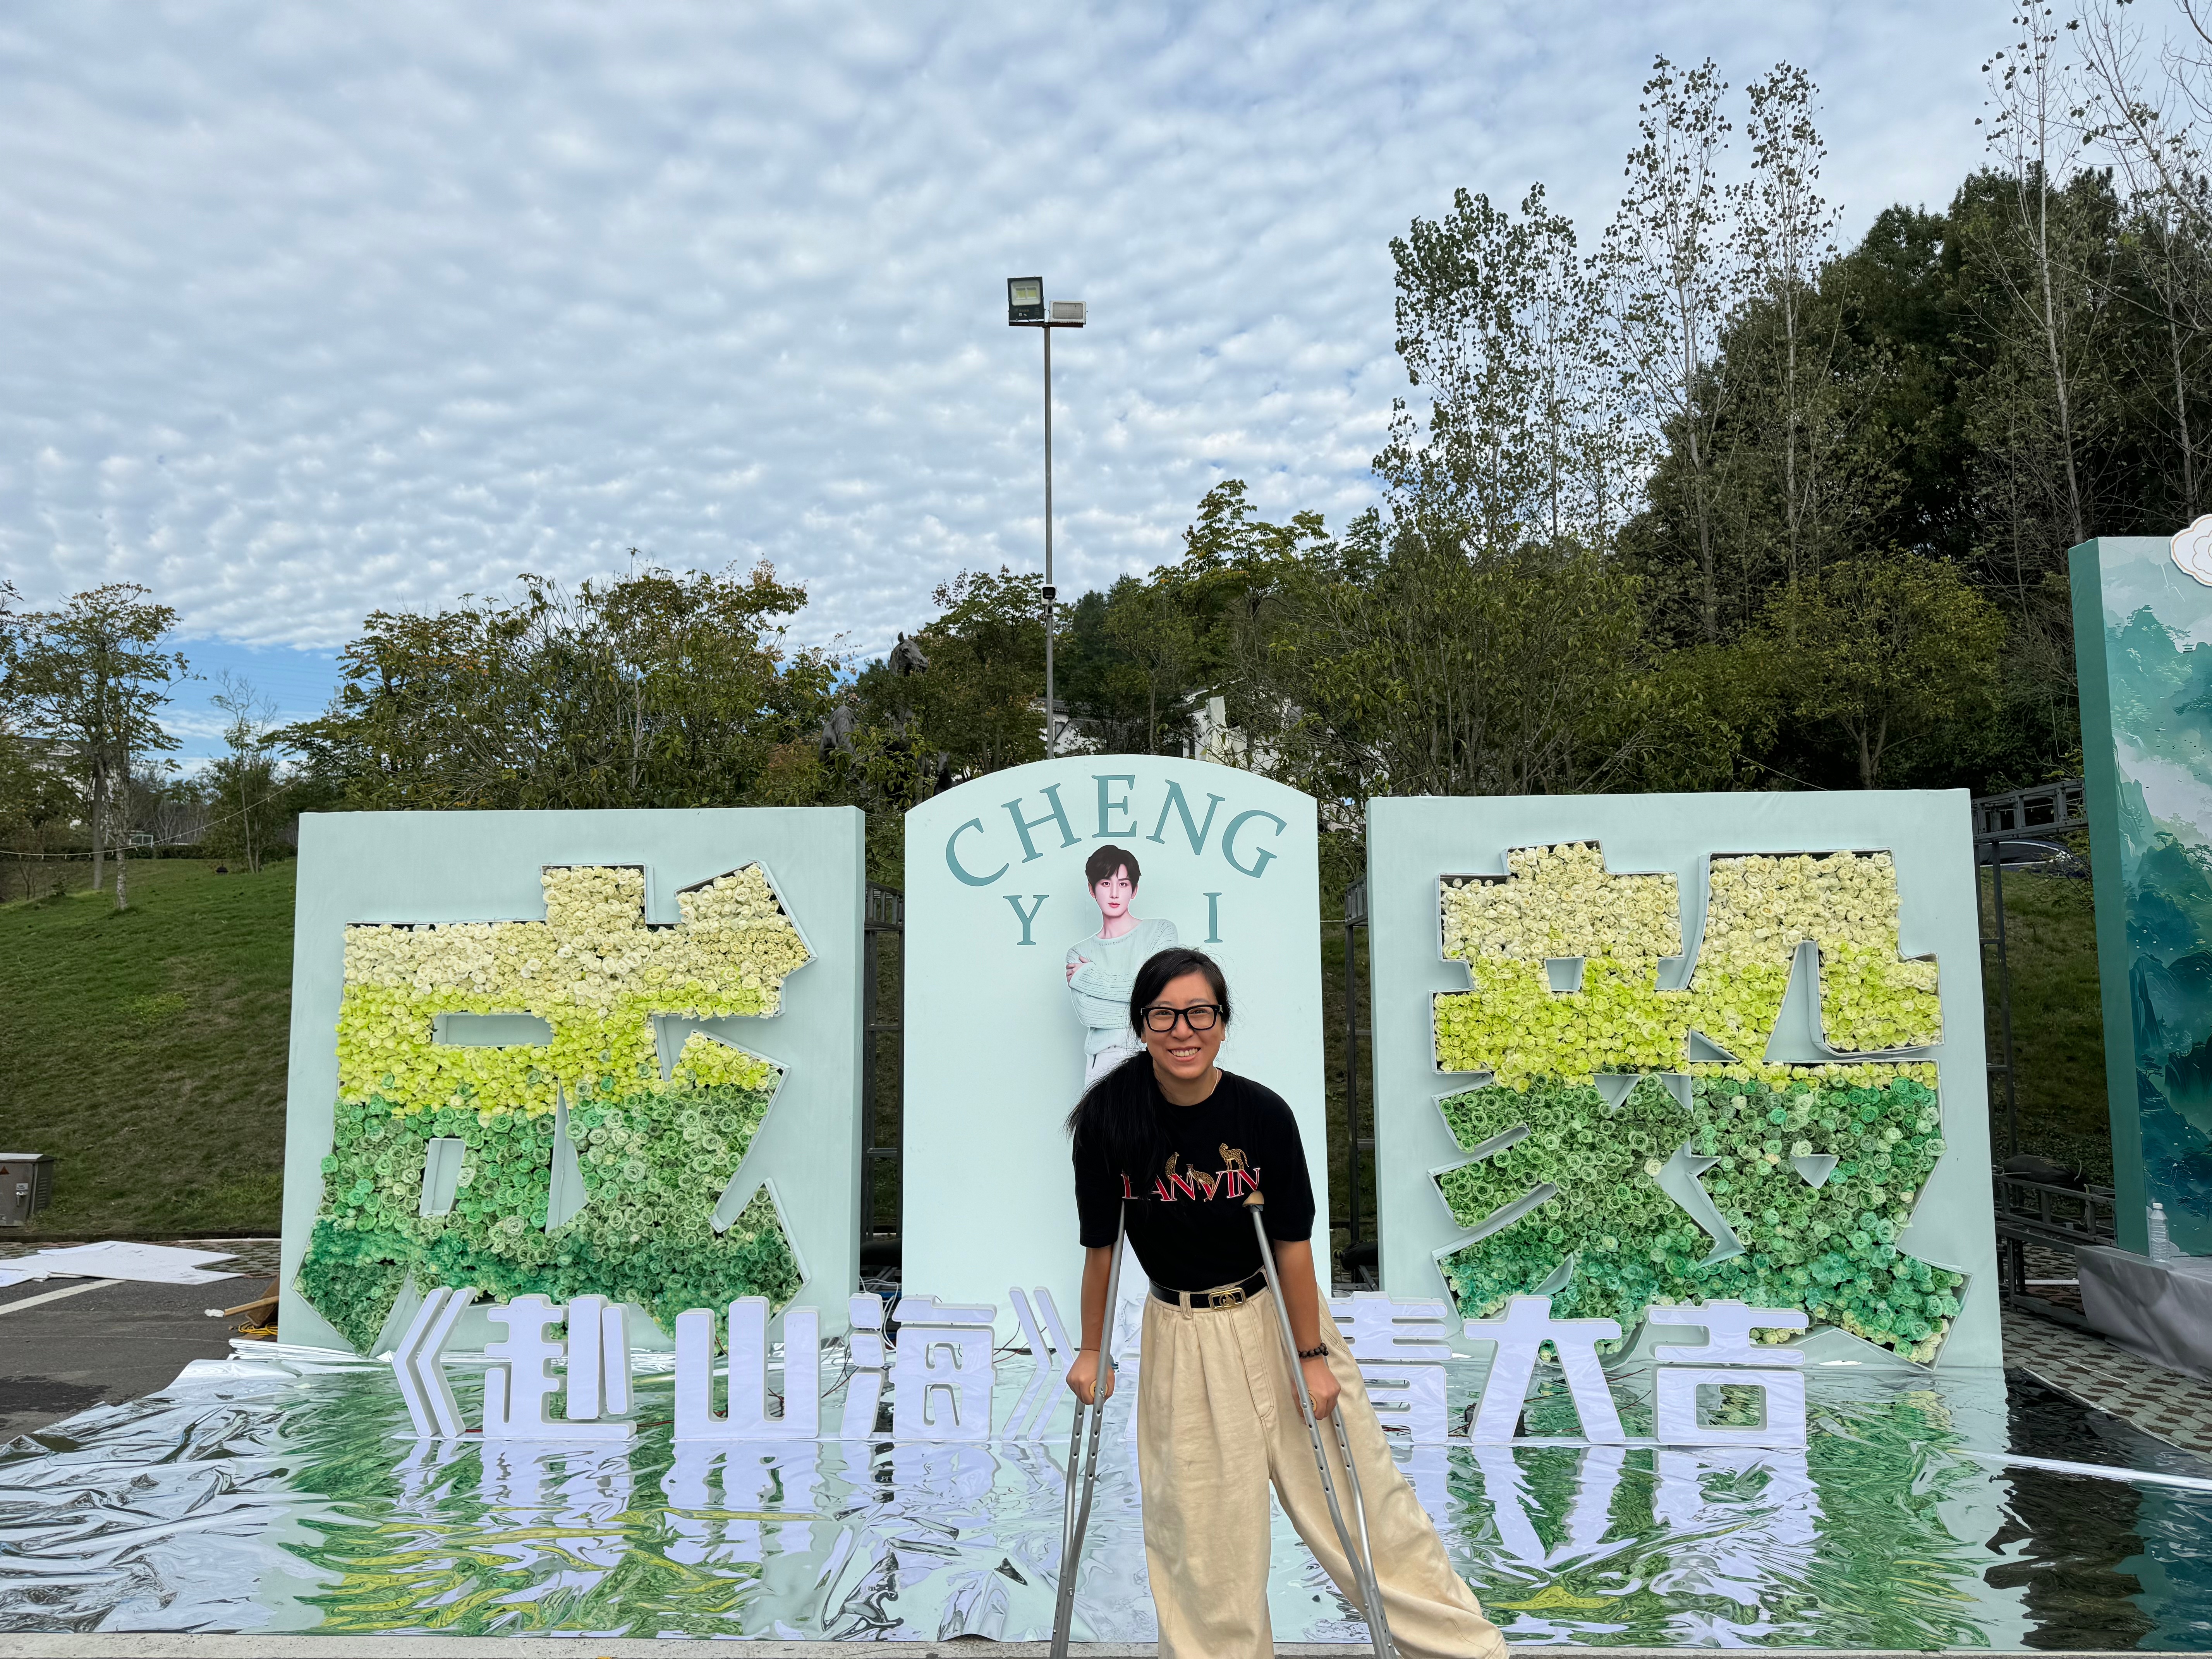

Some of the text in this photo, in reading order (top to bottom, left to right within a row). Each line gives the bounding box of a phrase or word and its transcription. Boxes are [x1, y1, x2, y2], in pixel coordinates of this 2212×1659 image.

[945, 774, 1287, 886] CHENG
[289, 860, 817, 1358] 成
[1427, 839, 1973, 1372] 毅
